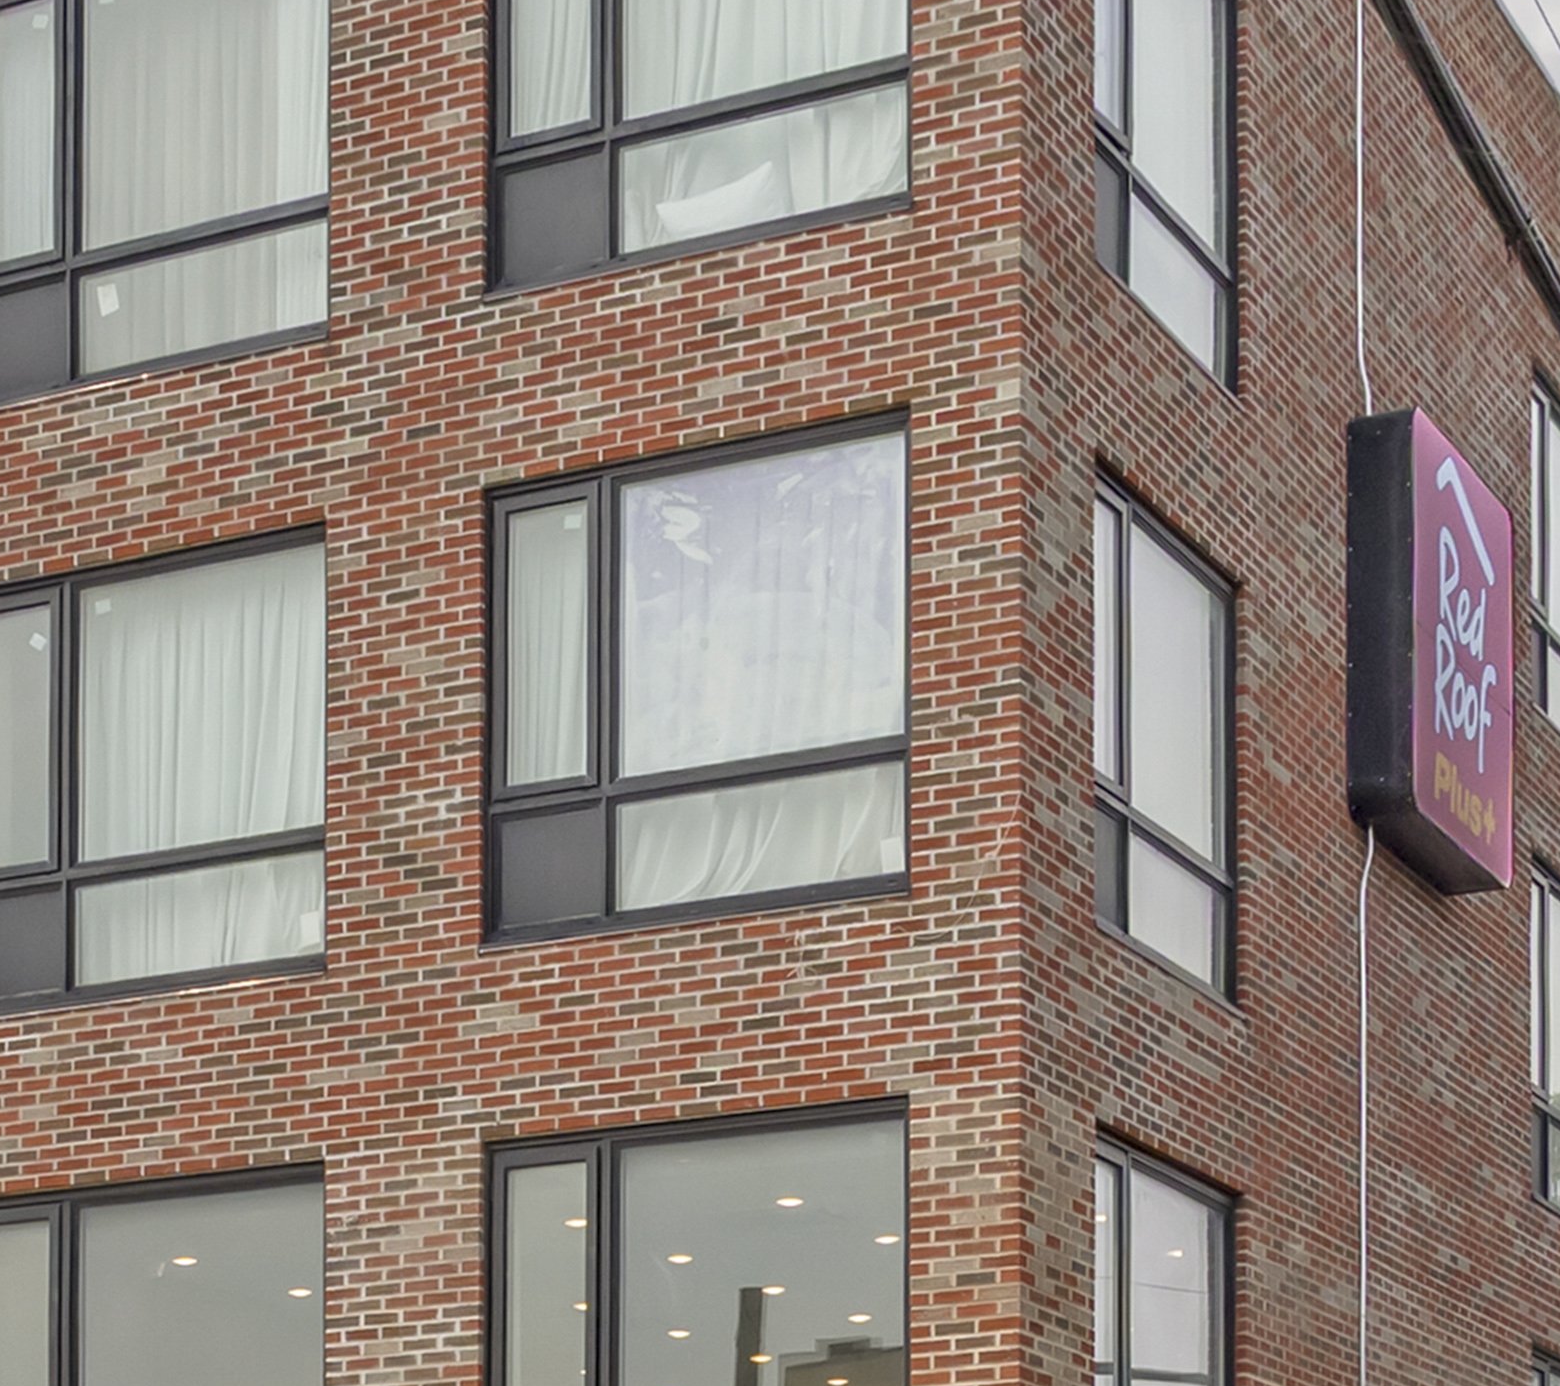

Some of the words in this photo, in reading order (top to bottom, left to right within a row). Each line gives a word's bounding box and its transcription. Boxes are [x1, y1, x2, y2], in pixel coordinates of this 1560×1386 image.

[1439, 525, 1487, 662] Red
[1434, 622, 1497, 774] Roof
[1434, 750, 1497, 846] Plus+
